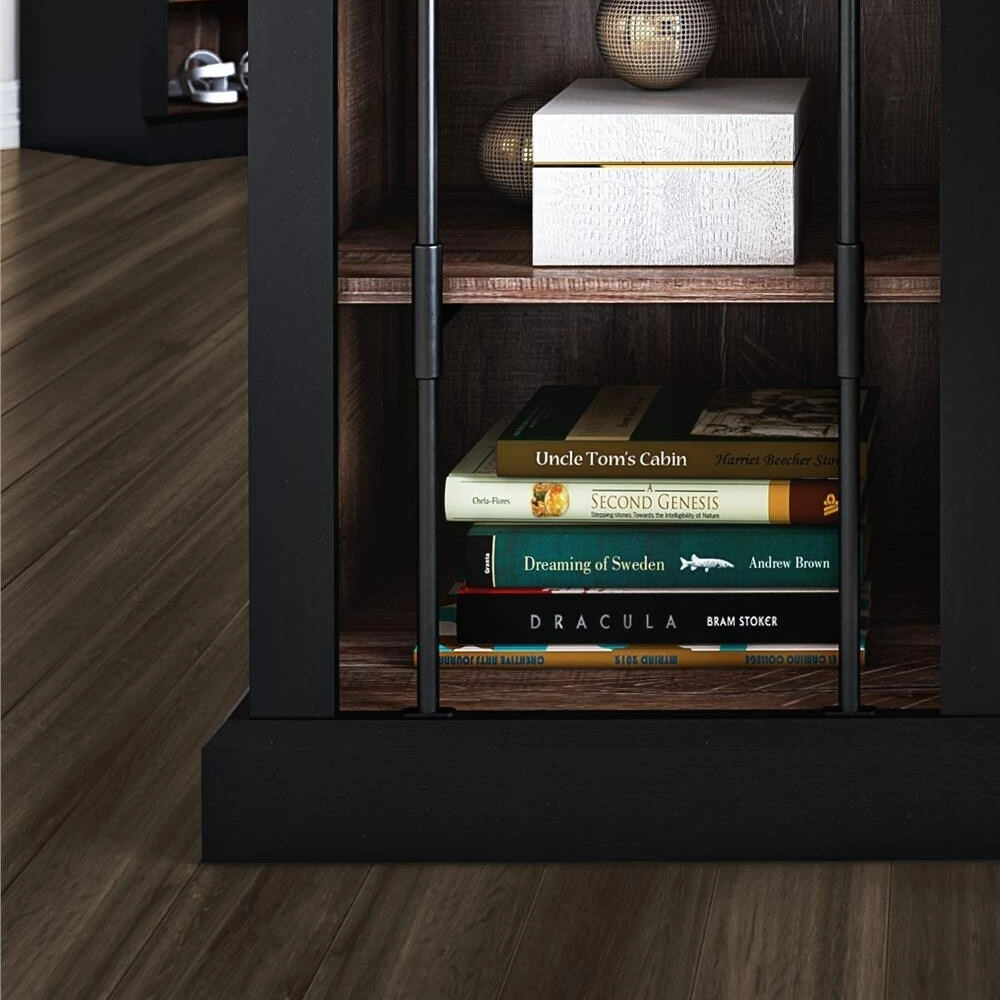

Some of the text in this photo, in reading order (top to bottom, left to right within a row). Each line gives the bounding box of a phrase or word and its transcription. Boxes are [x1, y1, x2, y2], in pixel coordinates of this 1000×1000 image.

[535, 450, 687, 466] Uncle Tom's Cabin
[715, 452, 839, 467] Harriet Beecher Sto
[647, 482, 653, 493] A
[591, 493, 719, 511] SECOND GENESIS
[633, 511, 654, 519] Towards
[655, 511, 664, 519] the
[695, 511, 701, 519] of
[524, 555, 665, 574] Dreaming of Sweden
[749, 555, 830, 569] Andrew Brown
[530, 614, 677, 629] DRACULA
[706, 616, 778, 627] BRAM STOKER
